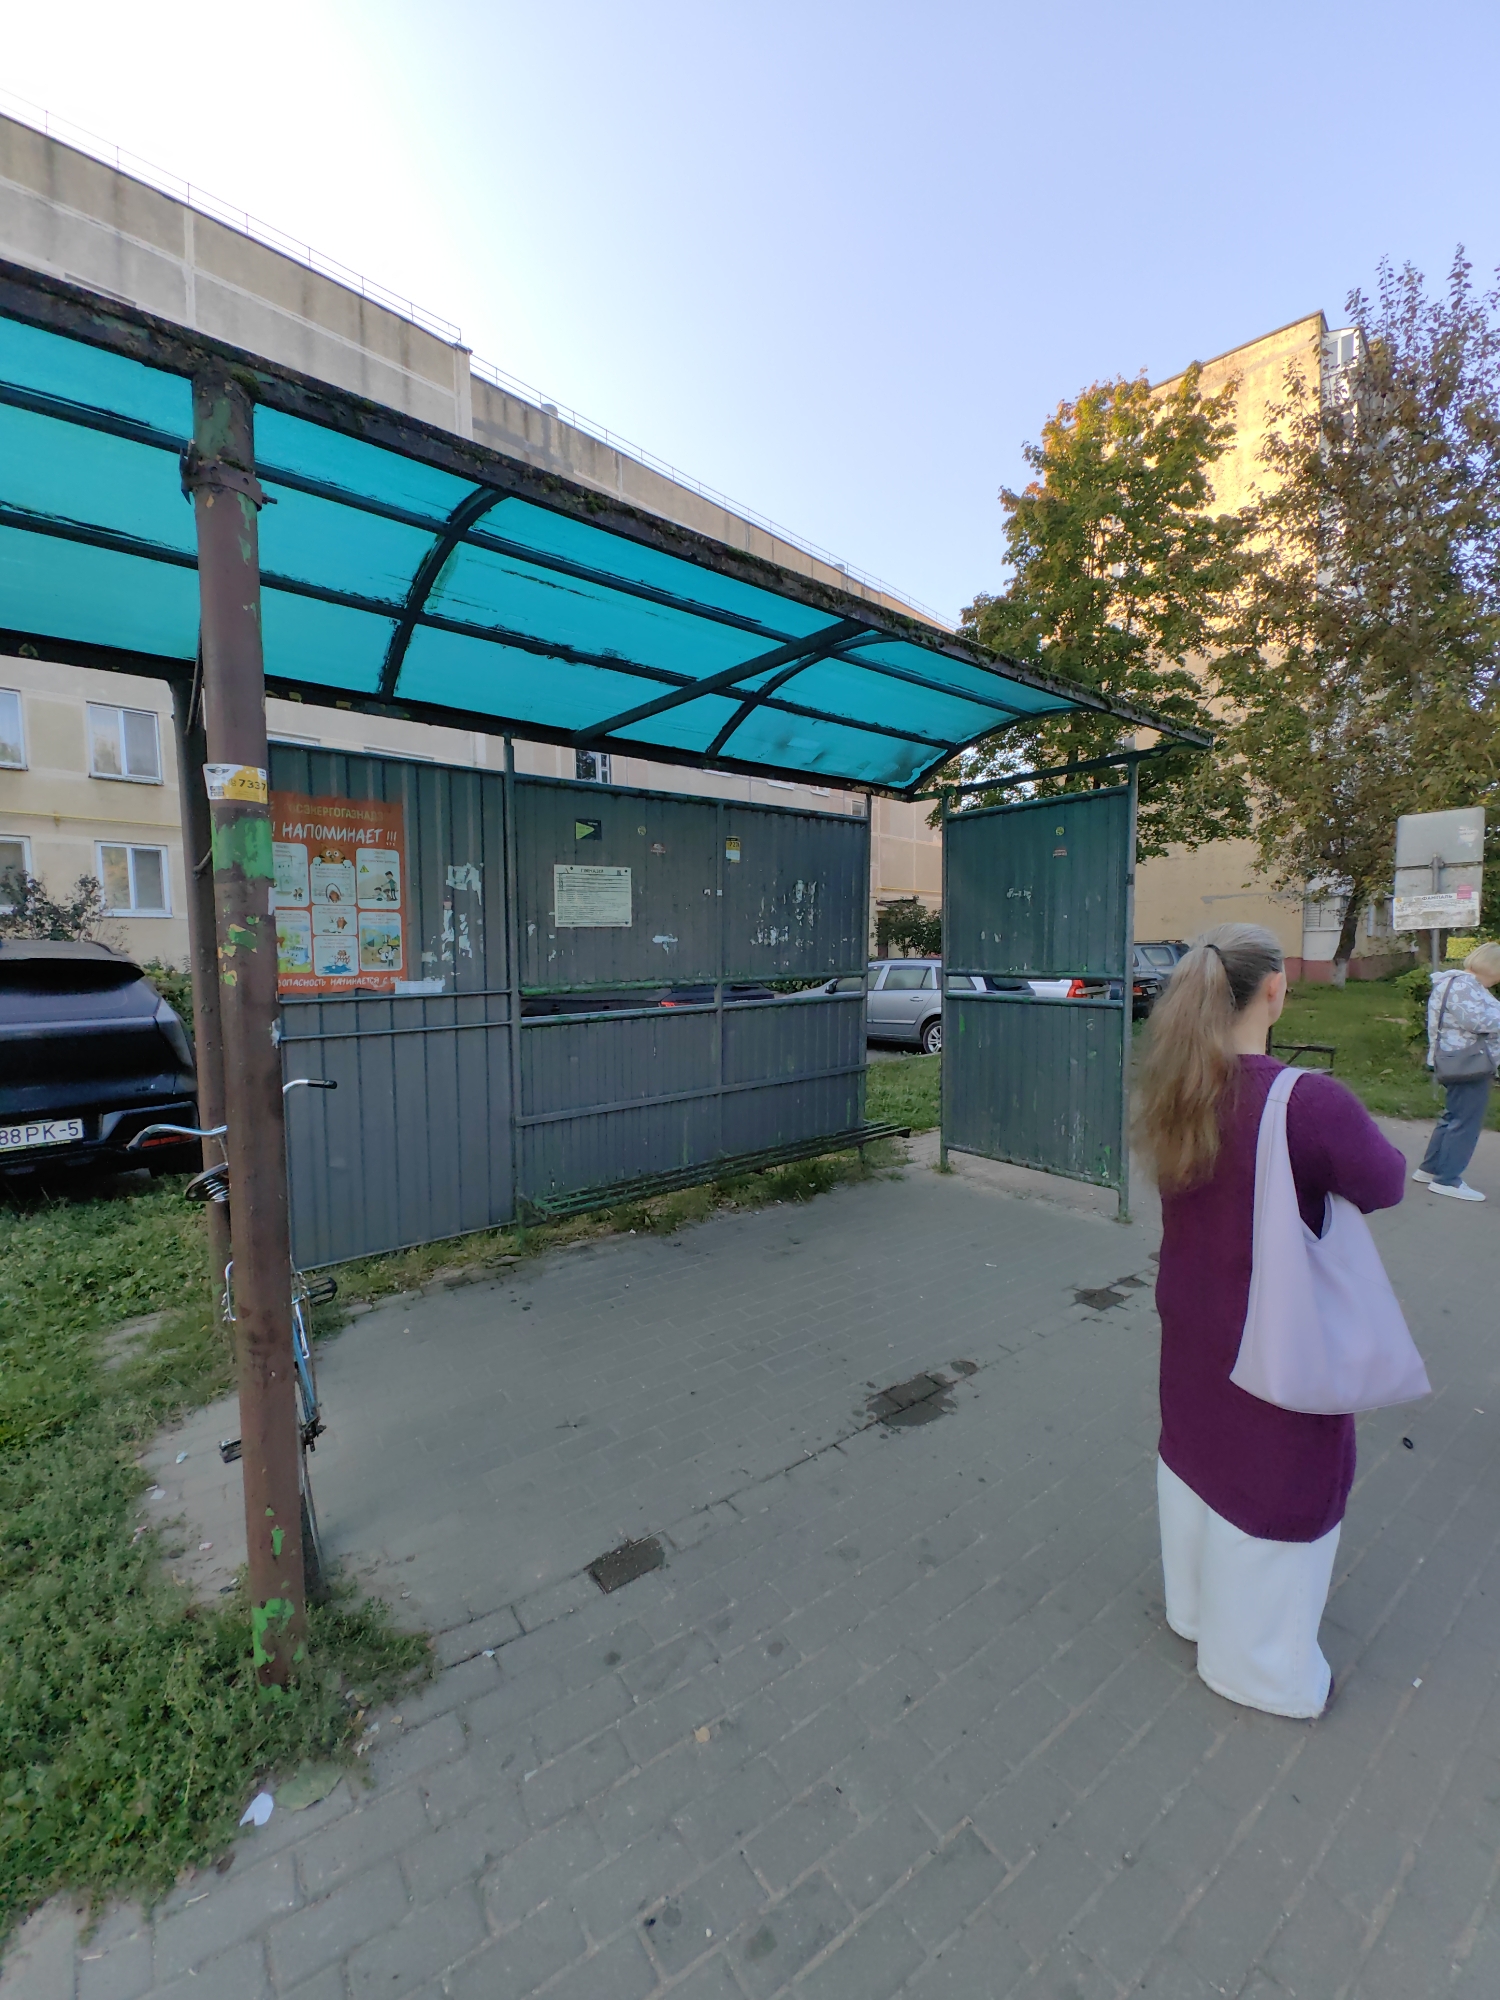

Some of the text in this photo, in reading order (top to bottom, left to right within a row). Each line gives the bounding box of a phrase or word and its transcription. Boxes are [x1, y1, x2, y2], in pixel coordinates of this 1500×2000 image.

[238, 778, 267, 791] 7337
[282, 821, 384, 844] НАПОМИНАЕТ
[330, 976, 380, 986] НАЧИНАЕТСЯ
